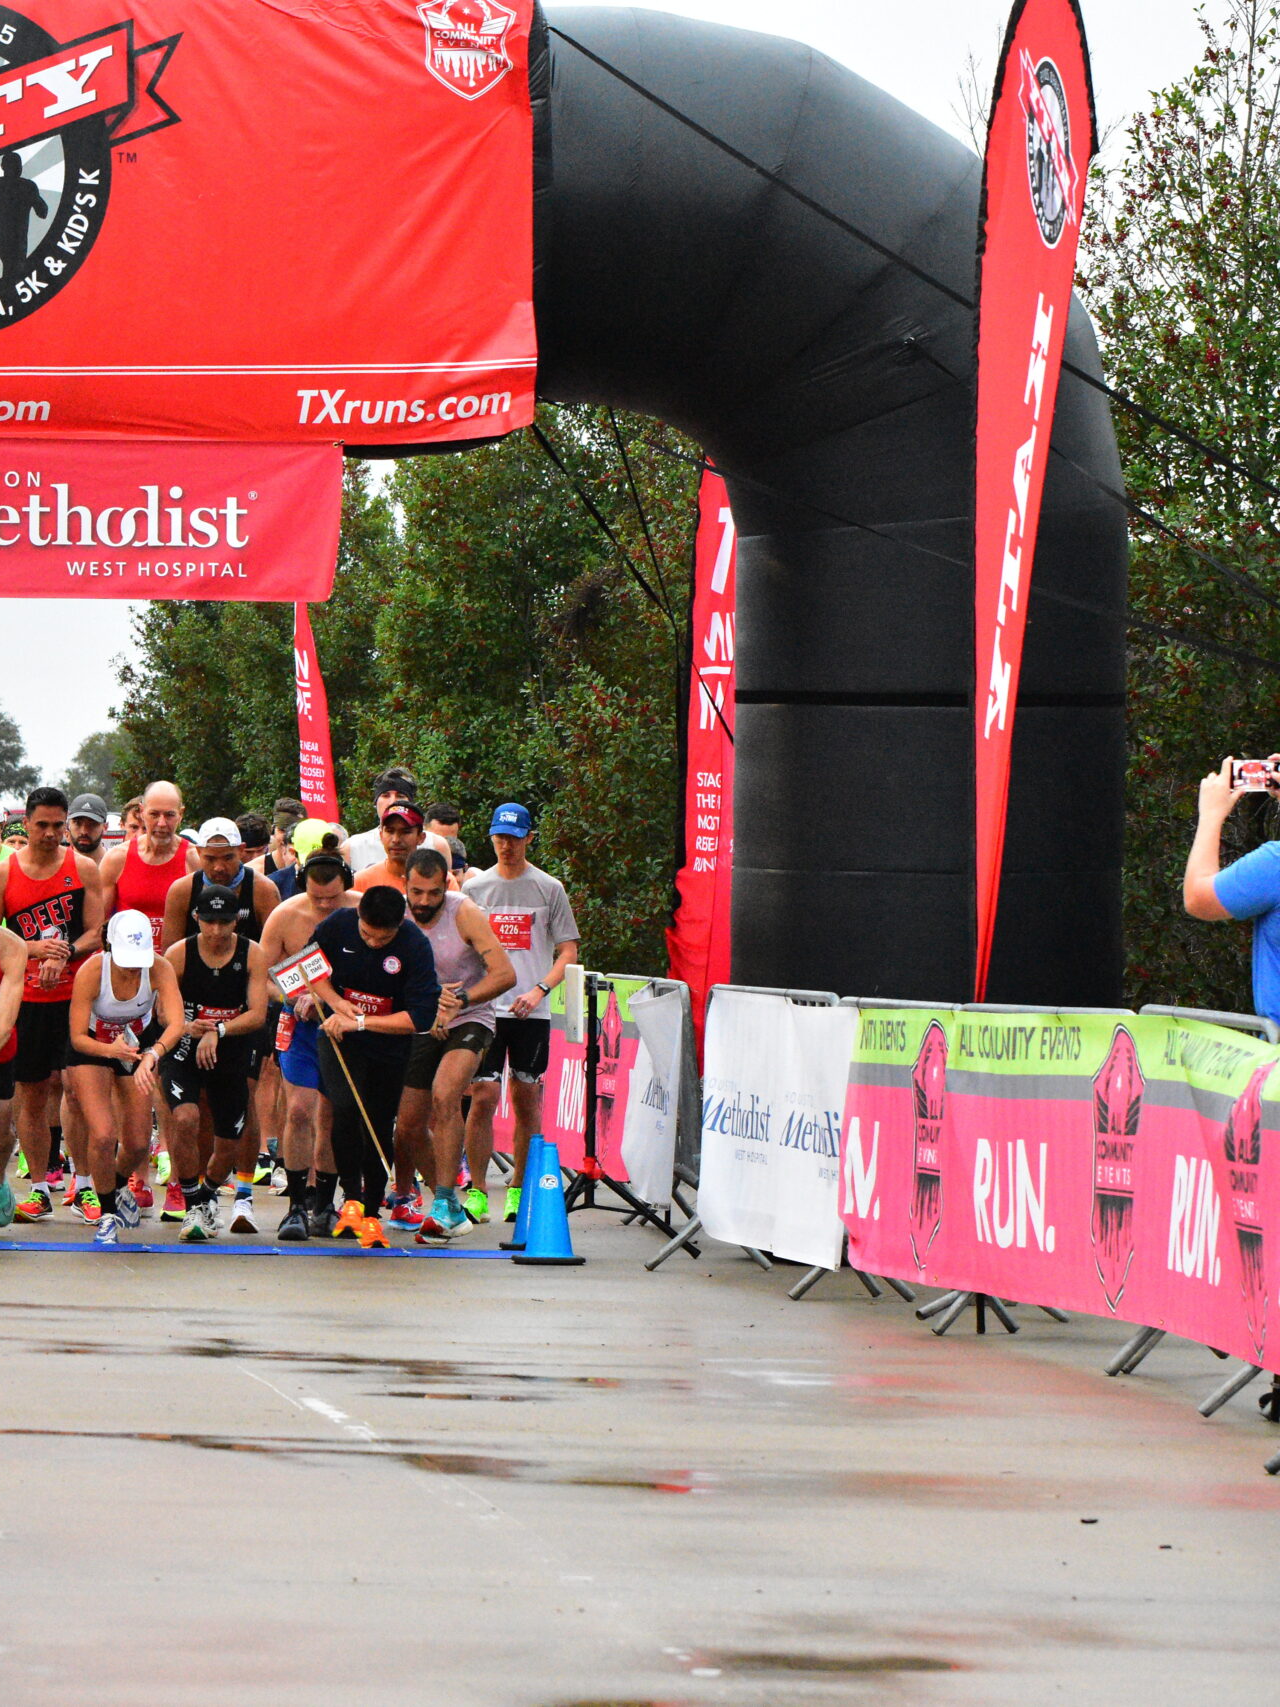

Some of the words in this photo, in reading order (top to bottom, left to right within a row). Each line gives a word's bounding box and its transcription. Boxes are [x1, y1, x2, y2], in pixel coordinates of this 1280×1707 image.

[16, 268, 50, 303] 5K
[43, 254, 67, 277] &
[56, 197, 100, 254] KID'S
[78, 168, 100, 185] K
[296, 389, 512, 425] TXruns.com
[66, 561, 128, 577] WEST
[136, 561, 248, 578] HOSPITAL
[696, 771, 723, 788] STAG
[314, 791, 326, 804] PAC
[16, 894, 74, 940] BEEF
[499, 923, 519, 935] 4226
[280, 972, 301, 989] 1:30
[304, 956, 323, 970] FINISH
[310, 964, 323, 974] TIME
[349, 991, 385, 1003] KATY
[1039, 1026, 1081, 1061] EVENTS
[973, 1138, 1056, 1254] RUN.
[1167, 1153, 1222, 1288] RUN.
